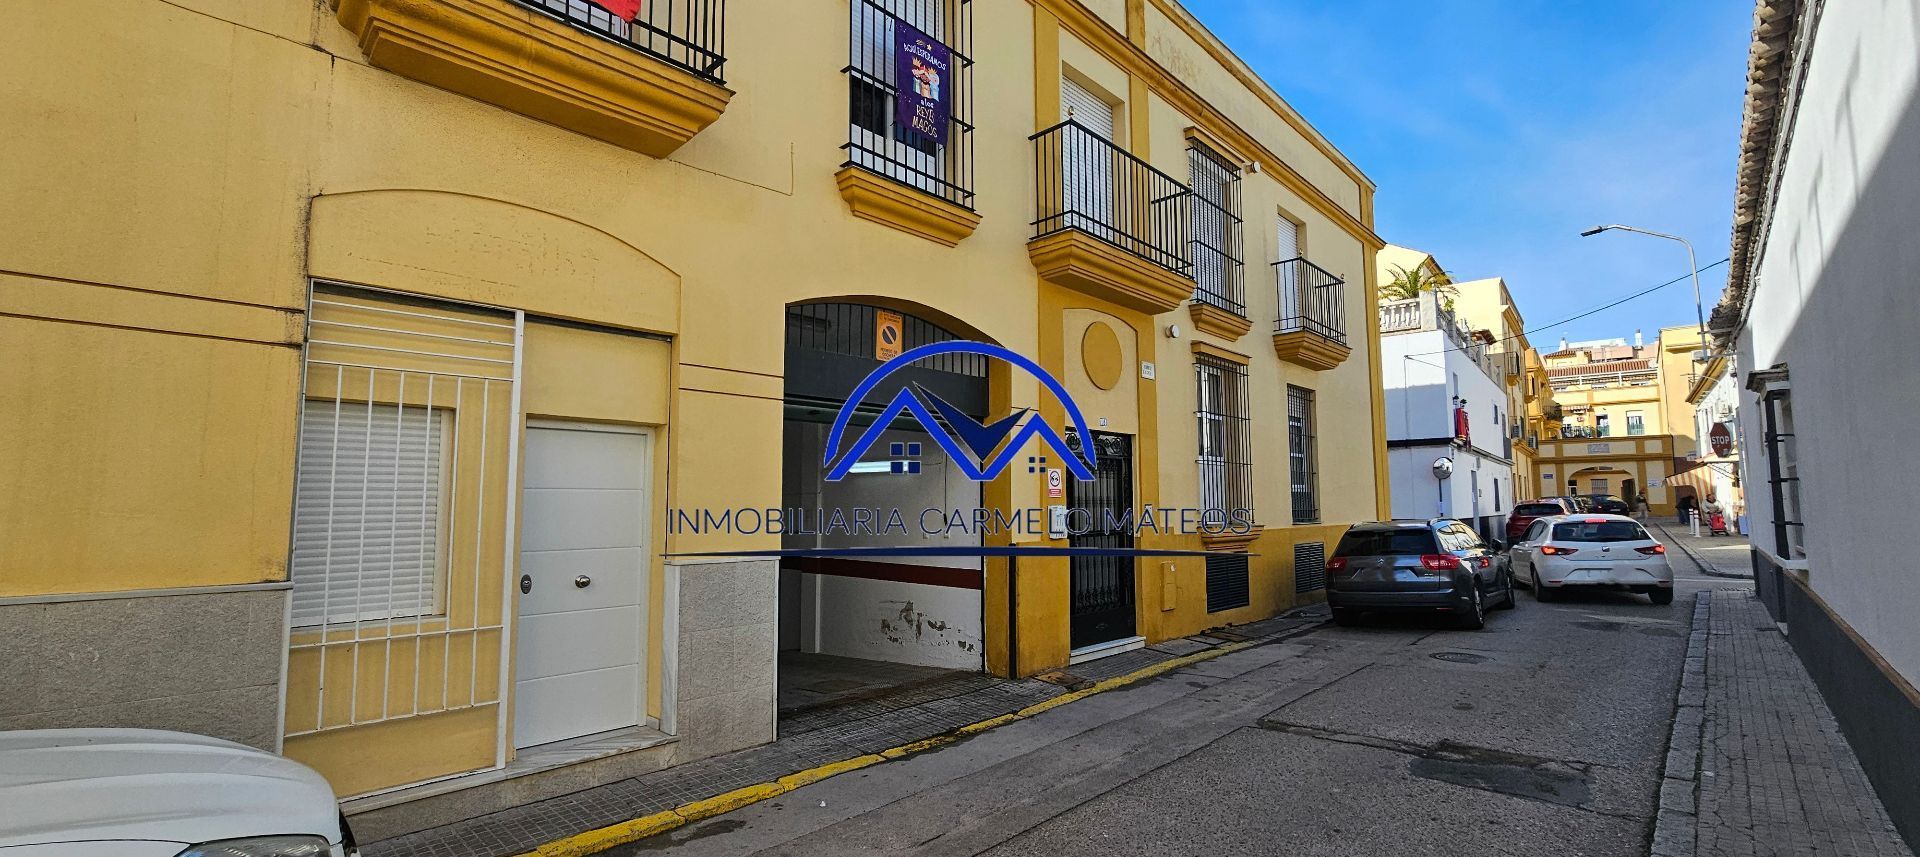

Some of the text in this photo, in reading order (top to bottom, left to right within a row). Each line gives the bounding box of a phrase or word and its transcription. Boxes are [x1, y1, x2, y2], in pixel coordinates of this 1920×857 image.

[916, 104, 934, 123] REYES
[912, 116, 937, 137] MAGOS
[1711, 436, 1729, 444] STOP
